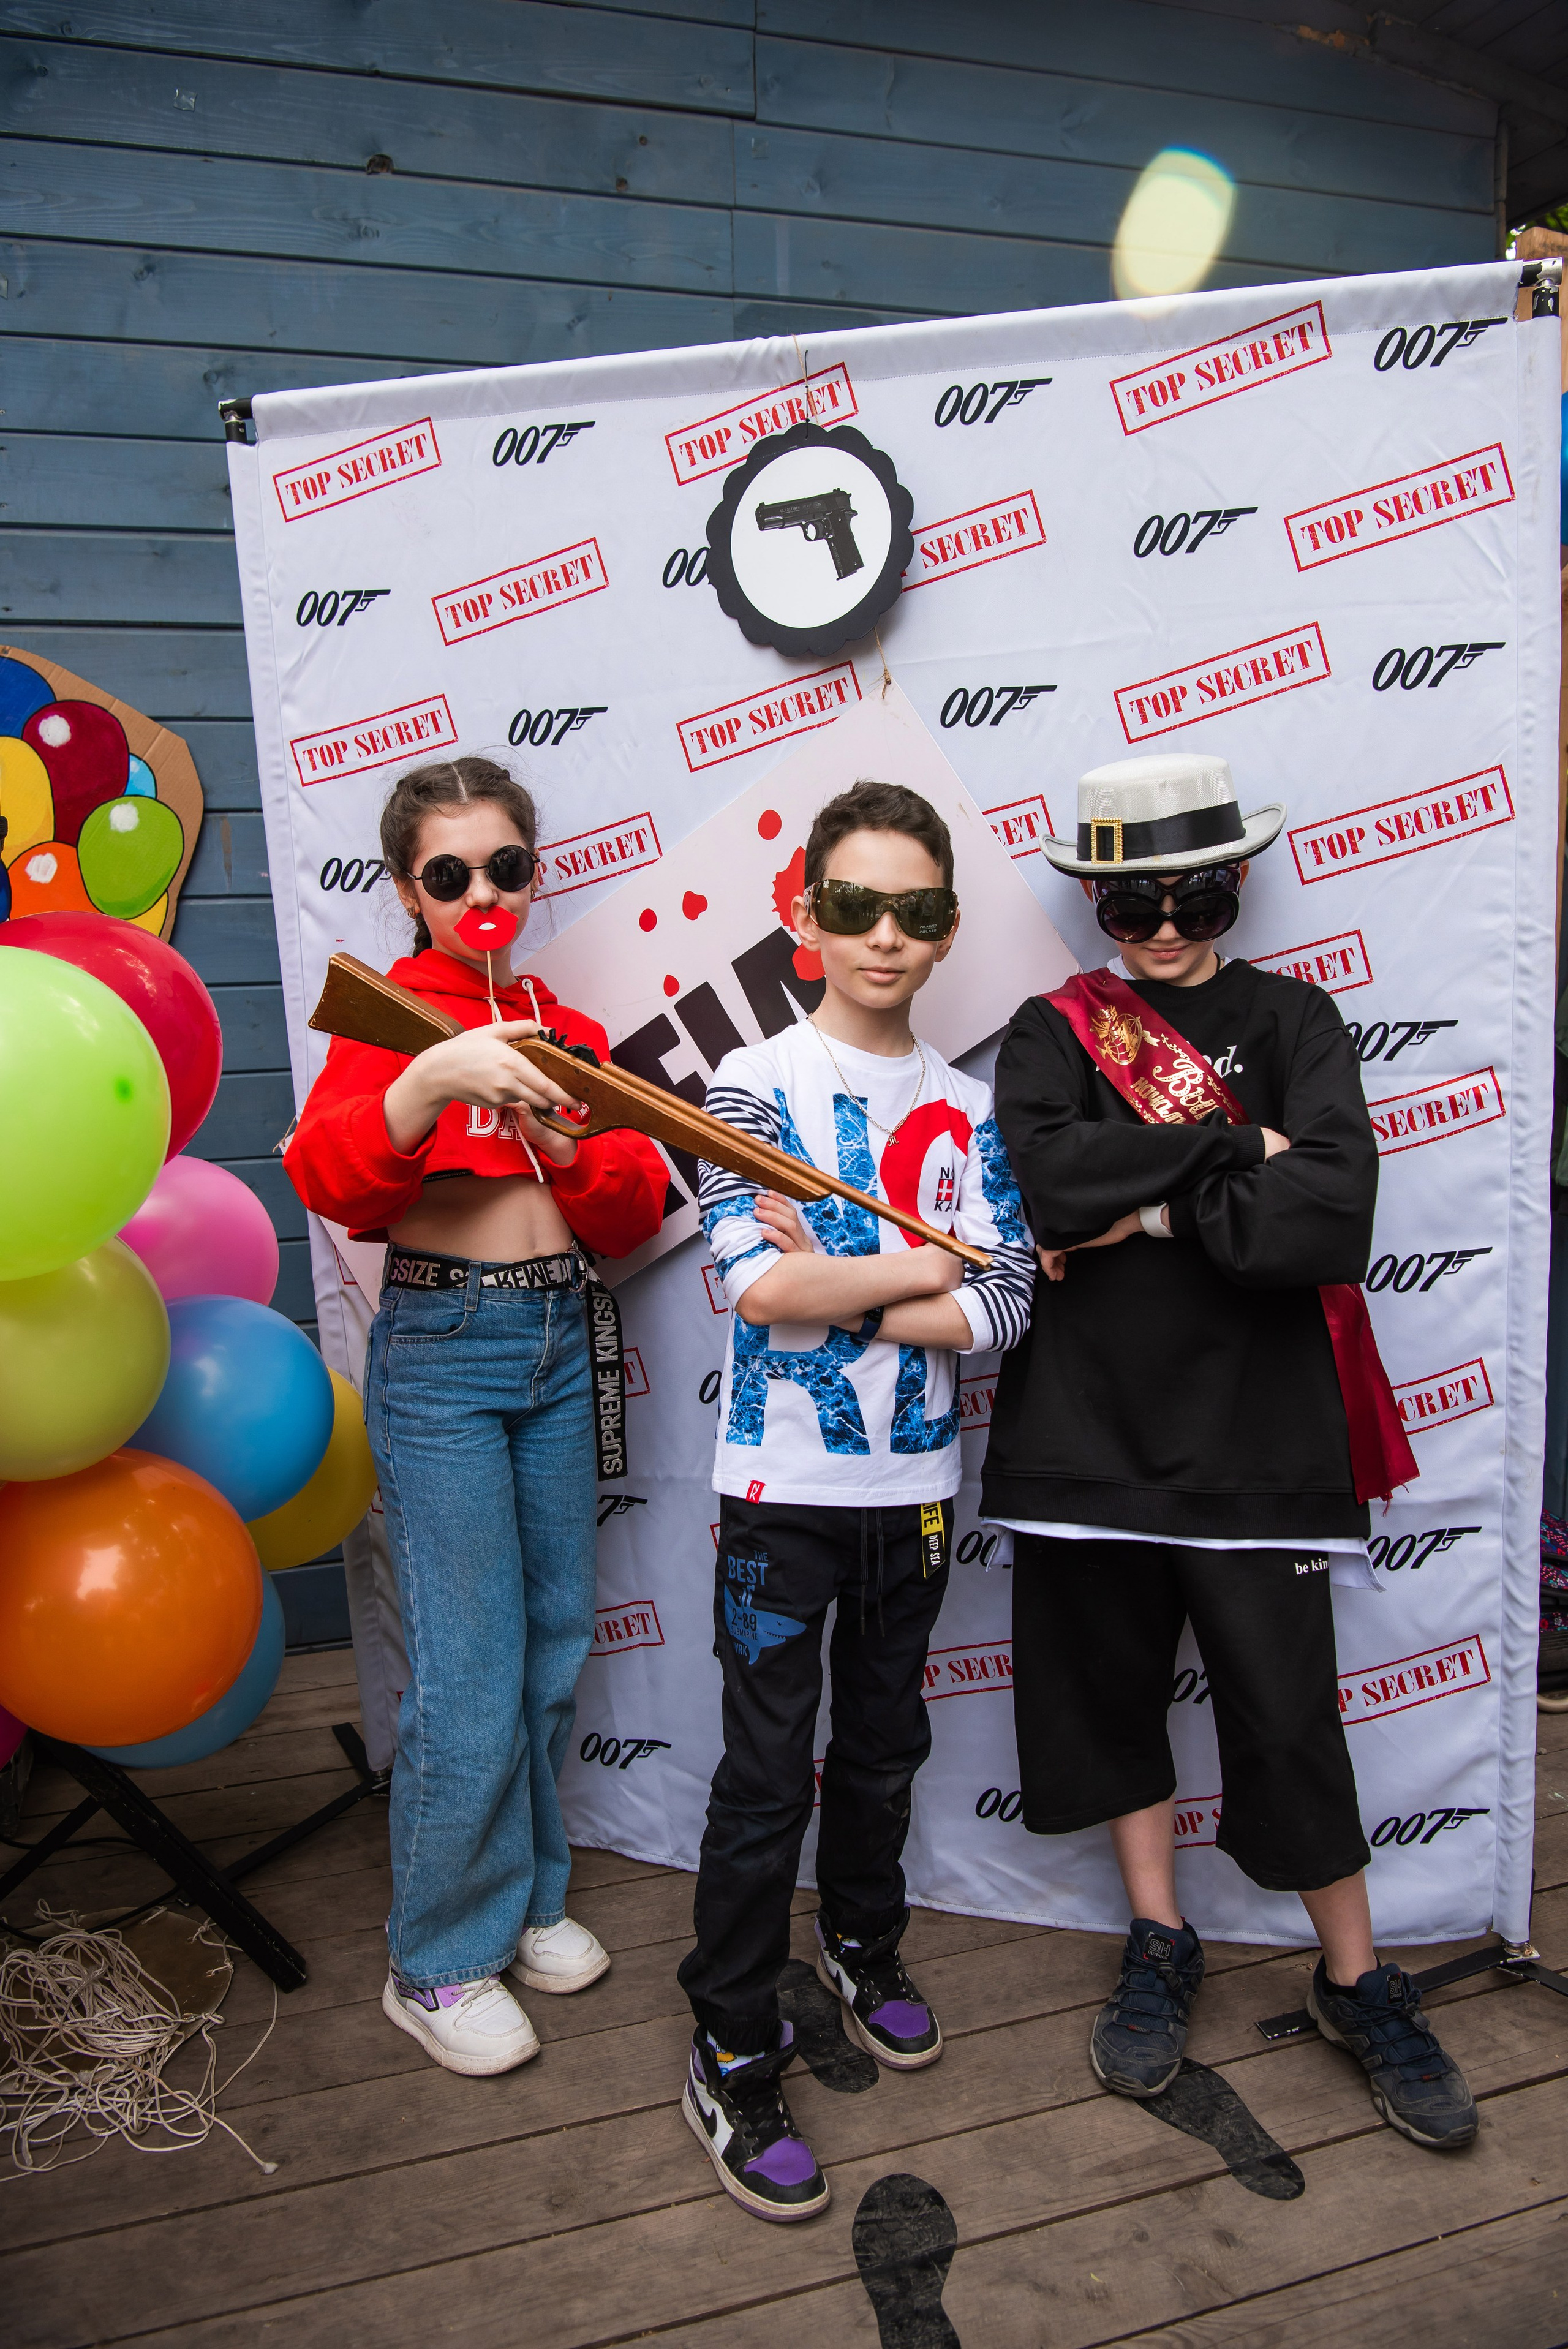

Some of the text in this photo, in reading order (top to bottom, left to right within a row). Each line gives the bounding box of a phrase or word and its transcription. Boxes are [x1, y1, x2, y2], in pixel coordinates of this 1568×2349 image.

[1374, 321, 1466, 371] 007
[1126, 321, 1314, 416] TOP SECRET
[678, 381, 843, 468] TOP SECRET
[935, 380, 1014, 427] 007
[493, 424, 568, 466] 007
[285, 433, 429, 507] TOP SECRET
[1300, 462, 1498, 552] TOP SECRET
[920, 508, 1030, 568] SECRET
[1133, 510, 1222, 558] 007
[662, 548, 711, 588] 00
[296, 590, 363, 626] 007
[445, 554, 594, 630] TOP SECRET
[1129, 639, 1314, 726] TOP SECRET
[1372, 643, 1467, 691] 007
[508, 708, 579, 746] 007
[690, 677, 849, 755] TOP SECRET
[940, 686, 1022, 728] 007
[302, 707, 444, 772] TOP SECRET
[1303, 783, 1499, 868] TOP SECRET
[320, 857, 386, 893] 007
[554, 827, 649, 881] SECRET
[1372, 1083, 1489, 1142] SECRET
[1366, 1251, 1457, 1293] 007
[1398, 1375, 1477, 1422] CRET
[597, 1370, 624, 1475] SUPREME
[728, 1555, 769, 1586] BEST
[929, 1534, 941, 1566] DEEP SEA
[1295, 1558, 1330, 1575] be kin
[731, 1608, 757, 1631] 2-89
[731, 1626, 758, 1641] SUBMARINE
[949, 1654, 1013, 1683] SECR
[1363, 1649, 1474, 1708] SECRET
[580, 1732, 646, 1770] 007
[975, 1787, 1022, 1823] 00
[1174, 1811, 1204, 1836] OP
[1370, 1808, 1455, 1847] 007
[1148, 1950, 1168, 1960] OUTDOOR
[1149, 1939, 1171, 1956] SH
[1389, 1979, 1403, 1994] SH
